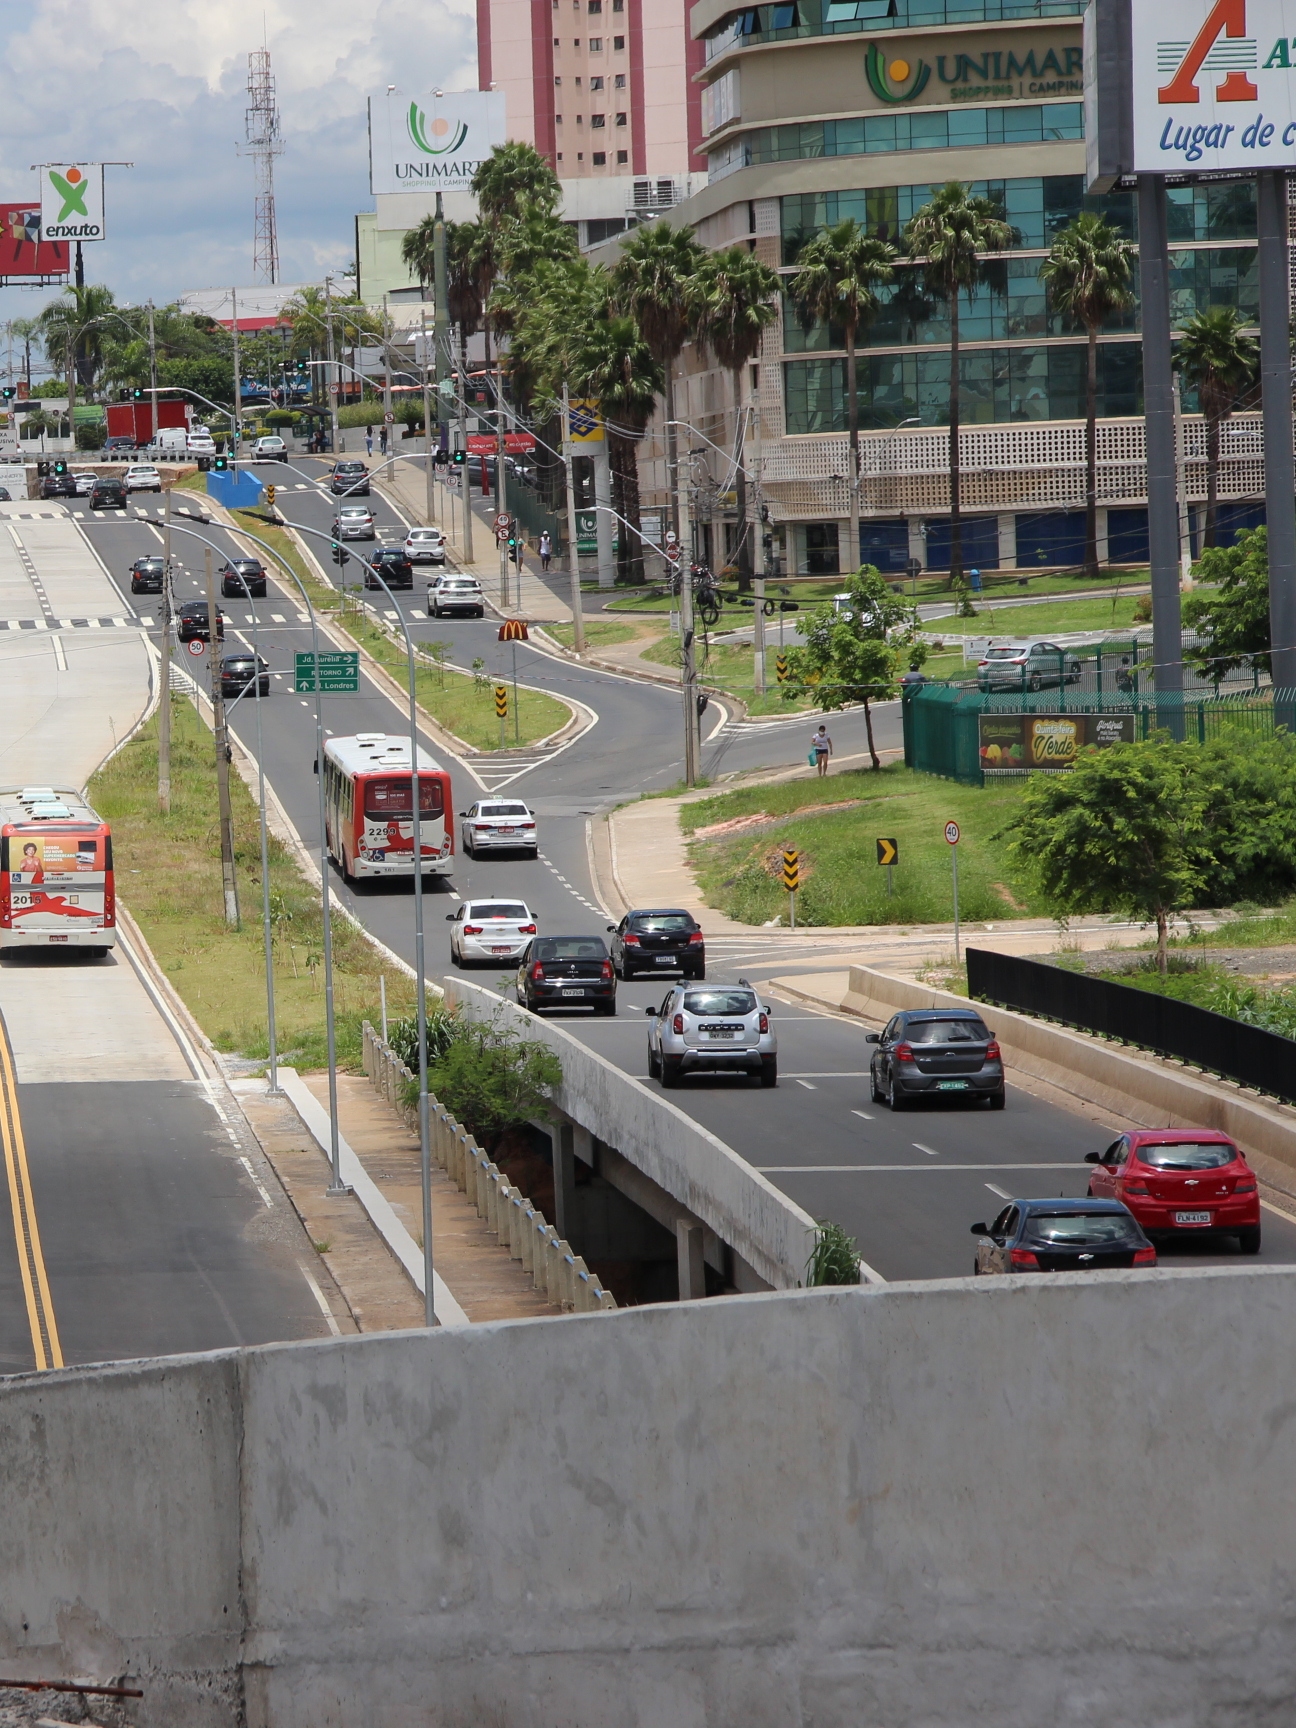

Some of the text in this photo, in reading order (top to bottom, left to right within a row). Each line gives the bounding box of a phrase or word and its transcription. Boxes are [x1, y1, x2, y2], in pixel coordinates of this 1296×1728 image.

[950, 84, 1014, 99] SHOPPING
[1159, 116, 1236, 162] Lugar
[1240, 112, 1276, 149] de
[402, 180, 436, 188] SHOPPING
[45, 223, 100, 237] enxuto
[1034, 723, 1075, 734] Quinta-feira
[1034, 735, 1075, 760] Verde
[368, 828, 396, 836] 2299
[947, 826, 957, 837] 40
